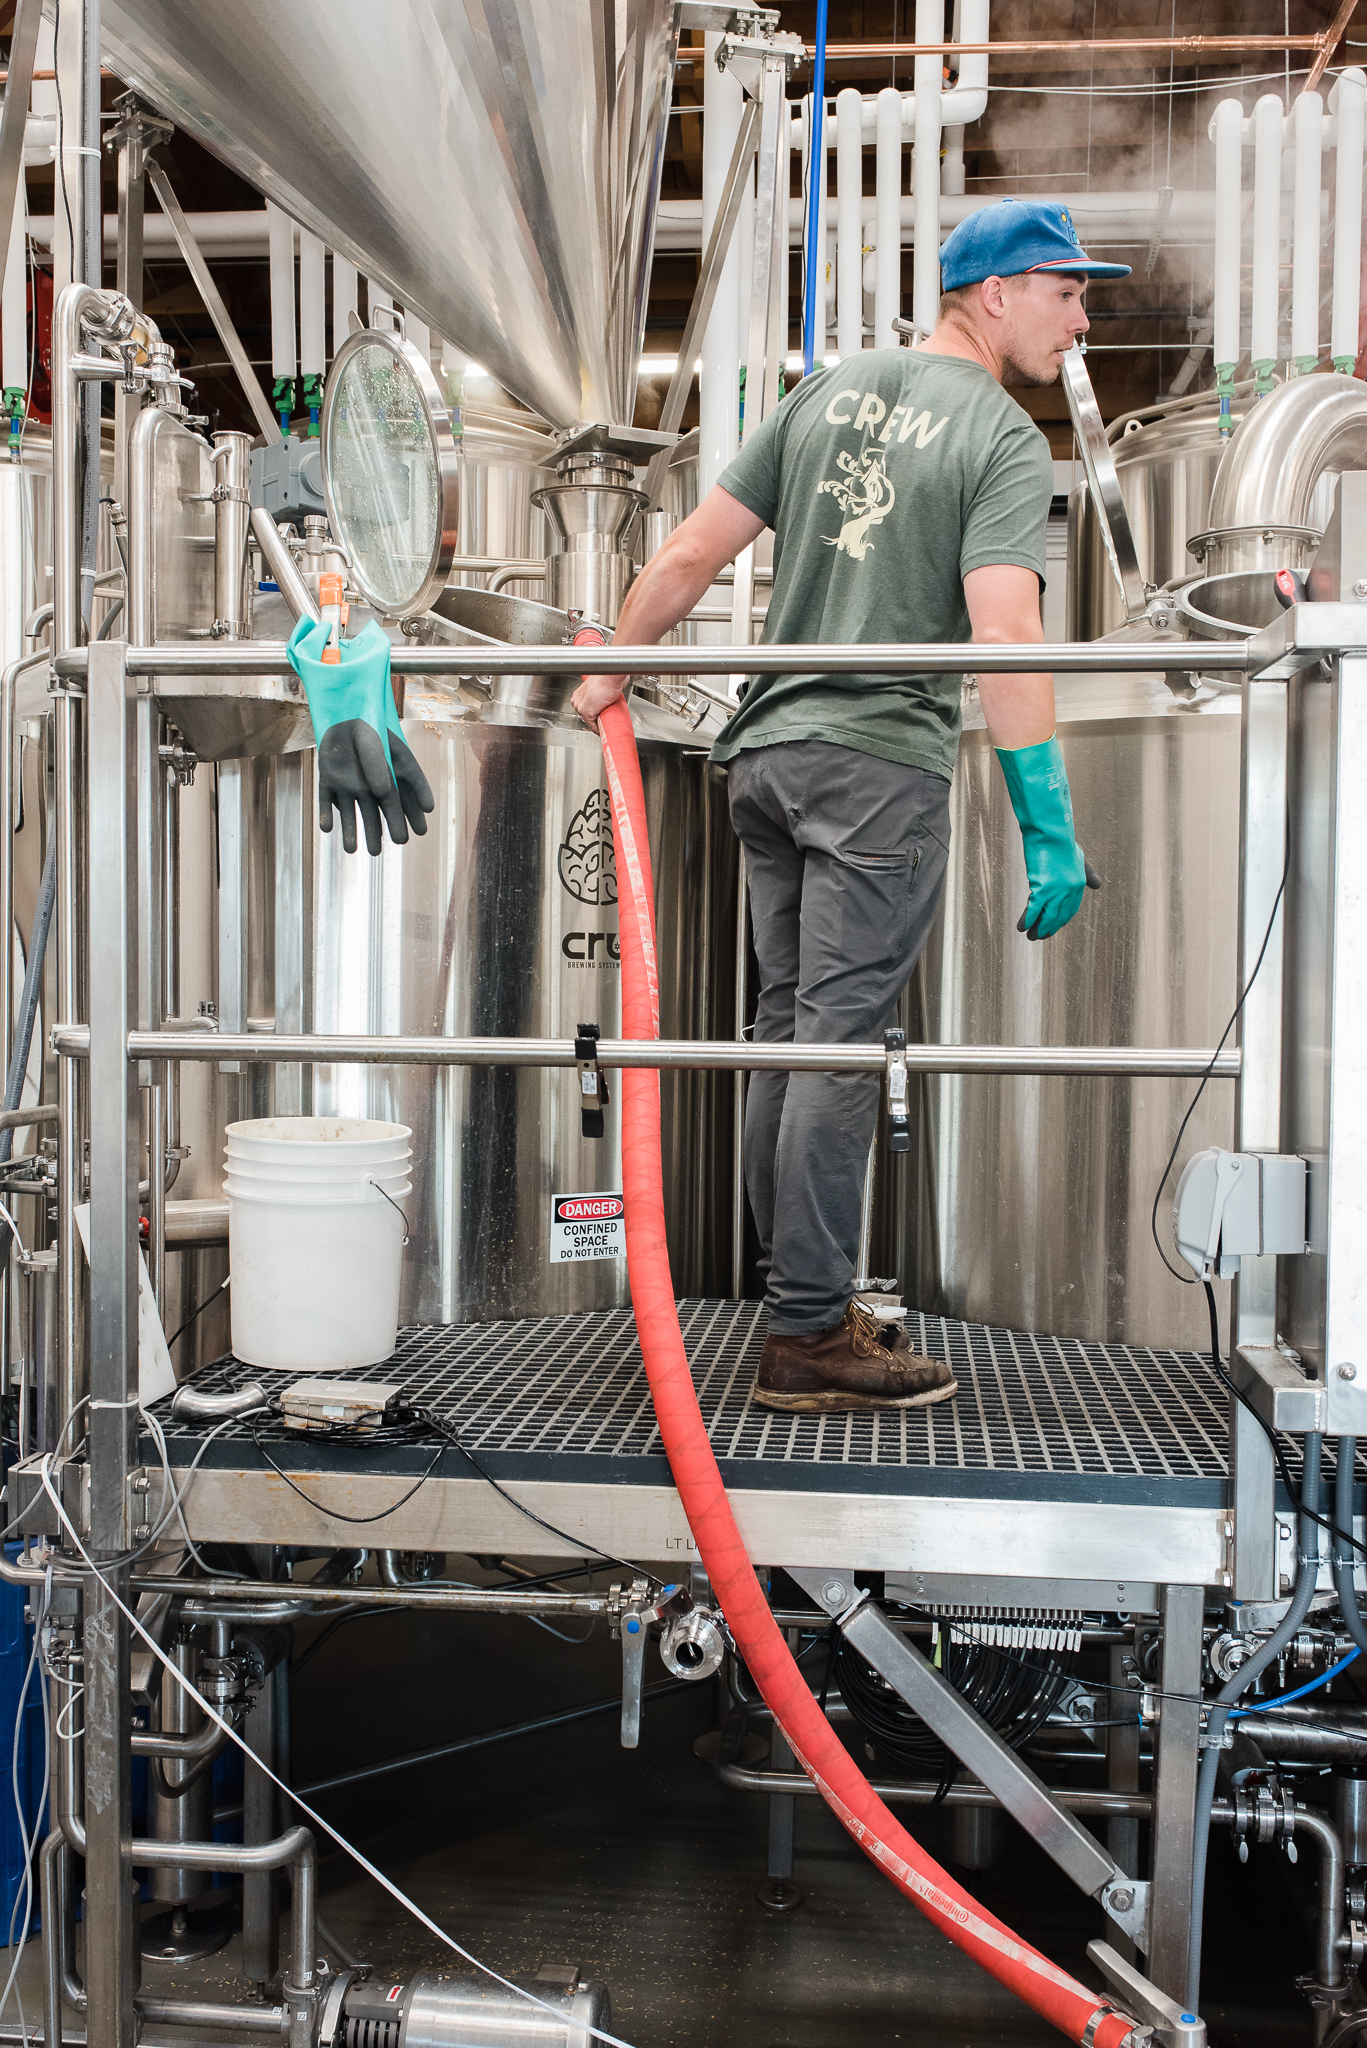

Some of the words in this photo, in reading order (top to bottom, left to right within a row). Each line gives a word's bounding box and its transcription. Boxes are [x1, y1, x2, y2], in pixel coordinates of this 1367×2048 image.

[825, 389, 950, 449] CREW
[565, 1201, 617, 1217] DANGER
[563, 1222, 618, 1236] CONFINED
[573, 1235, 608, 1247] SPACE
[560, 1249, 573, 1259] DO
[574, 1248, 592, 1258] NOT
[593, 1246, 619, 1256] ENTER
[665, 1537, 683, 1550] LT
[923, 1886, 970, 1924] Continental
[297, 2012, 307, 2020] 22
